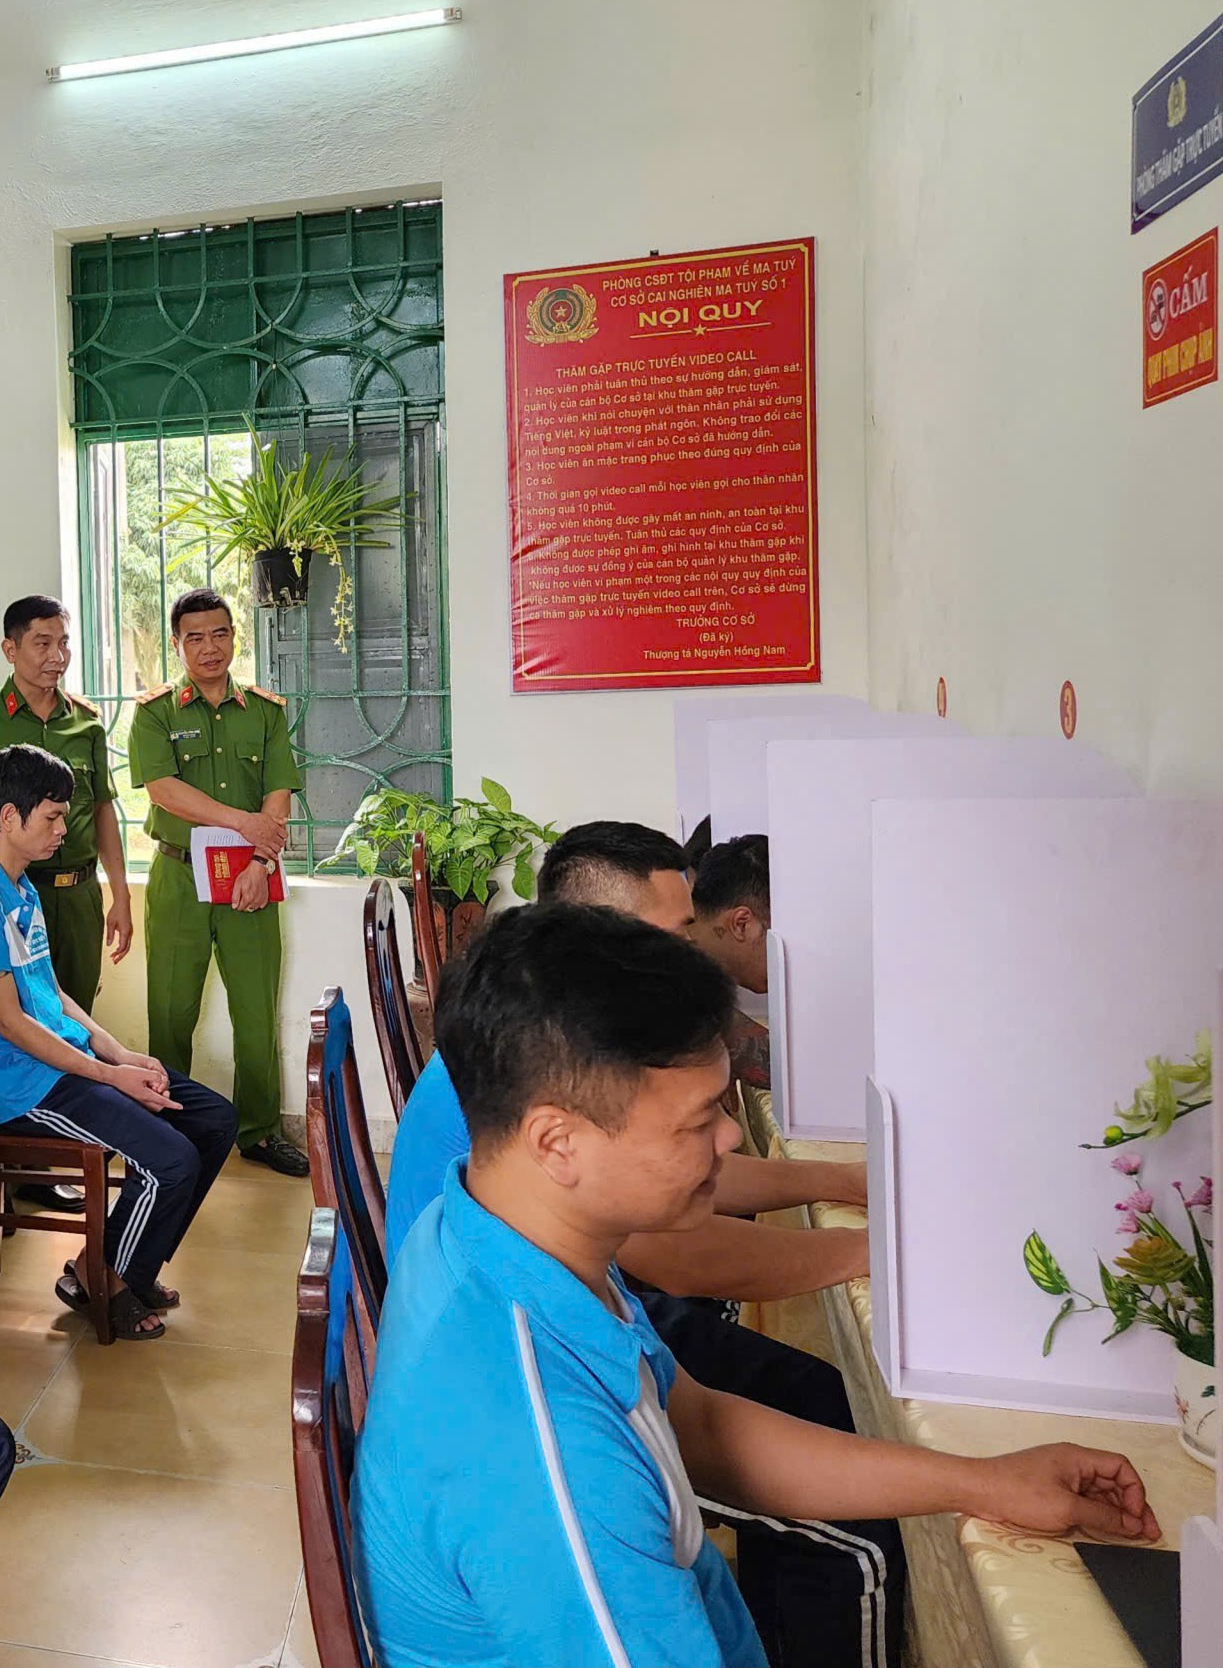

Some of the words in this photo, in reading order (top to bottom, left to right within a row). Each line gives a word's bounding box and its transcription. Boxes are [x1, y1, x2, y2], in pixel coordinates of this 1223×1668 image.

[602, 275, 641, 290] PHÒNG
[644, 273, 674, 286] CSĐT
[677, 268, 695, 284] TỘI
[698, 266, 730, 280] PHẠM
[734, 260, 749, 276] VỀ
[753, 262, 770, 274] MA
[773, 256, 795, 271] TUÝ
[610, 295, 627, 307] CƠ
[628, 291, 645, 305] SỞ
[647, 291, 665, 303] CAI
[668, 284, 711, 301] NGHIỆN
[715, 284, 732, 296] MA
[735, 278, 758, 293] TUÝ
[761, 274, 777, 291] SỐ
[780, 278, 785, 289] 1
[1169, 265, 1208, 319] CẤM
[638, 307, 688, 328] NỘI
[698, 299, 762, 321] QUY
[556, 364, 586, 378] THĂM
[589, 361, 612, 376] GẶP
[614, 360, 645, 373] TRỰC
[648, 353, 685, 369] TUYẾN
[689, 353, 723, 365] VIDEO
[726, 349, 756, 362] CALL
[650, 375, 672, 385] theo
[657, 390, 675, 399] khu
[582, 412, 596, 421] khi
[614, 425, 641, 434] trong
[740, 415, 761, 423] trao
[620, 455, 647, 464] trang
[678, 450, 700, 459] theo
[732, 447, 752, 458] quy
[560, 489, 580, 500] gian
[600, 486, 626, 495] video
[628, 484, 645, 493] call
[731, 477, 750, 486] cho
[578, 503, 588, 512] 10
[728, 510, 740, 518] an
[785, 504, 803, 514] khu
[675, 614, 719, 627] TRƯỞNG
[722, 615, 737, 625] CƠ
[739, 612, 755, 624] SỞ
[699, 632, 715, 643] (Đã
[718, 631, 733, 643] ký)
[643, 650, 679, 660] Thượng
[681, 648, 691, 657] tá
[694, 645, 731, 659] Nguyễn
[733, 644, 760, 657] Hồng
[763, 645, 785, 655] Nam
